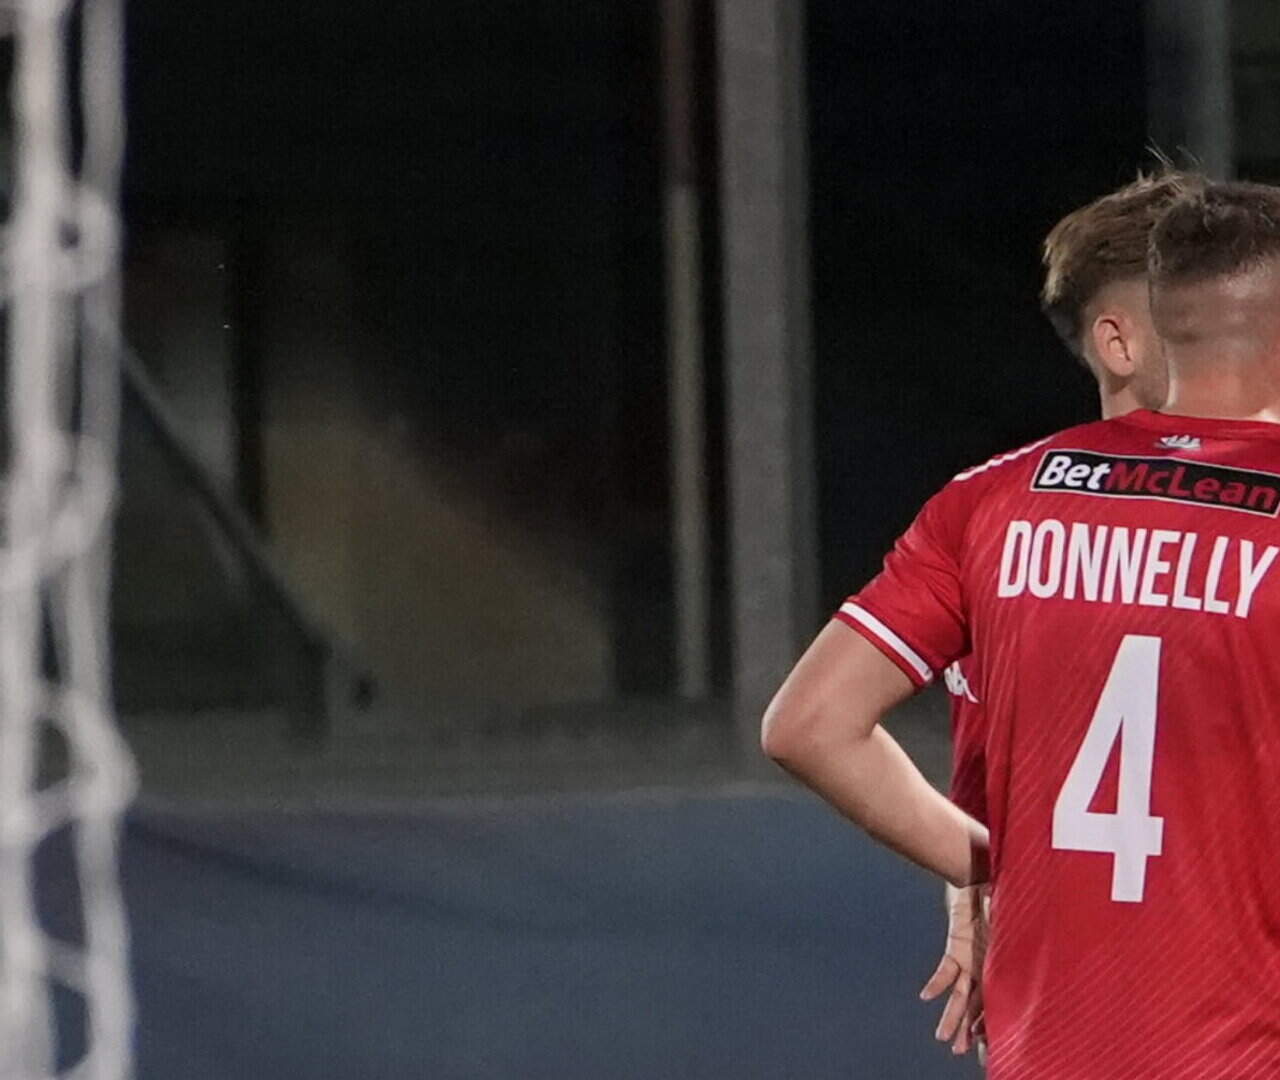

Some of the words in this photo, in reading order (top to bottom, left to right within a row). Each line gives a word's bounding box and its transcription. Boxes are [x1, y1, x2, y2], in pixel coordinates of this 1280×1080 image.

[1038, 455, 1279, 510] BetMcLean
[997, 519, 1280, 619] DONNELLY
[1052, 634, 1164, 902] 4
